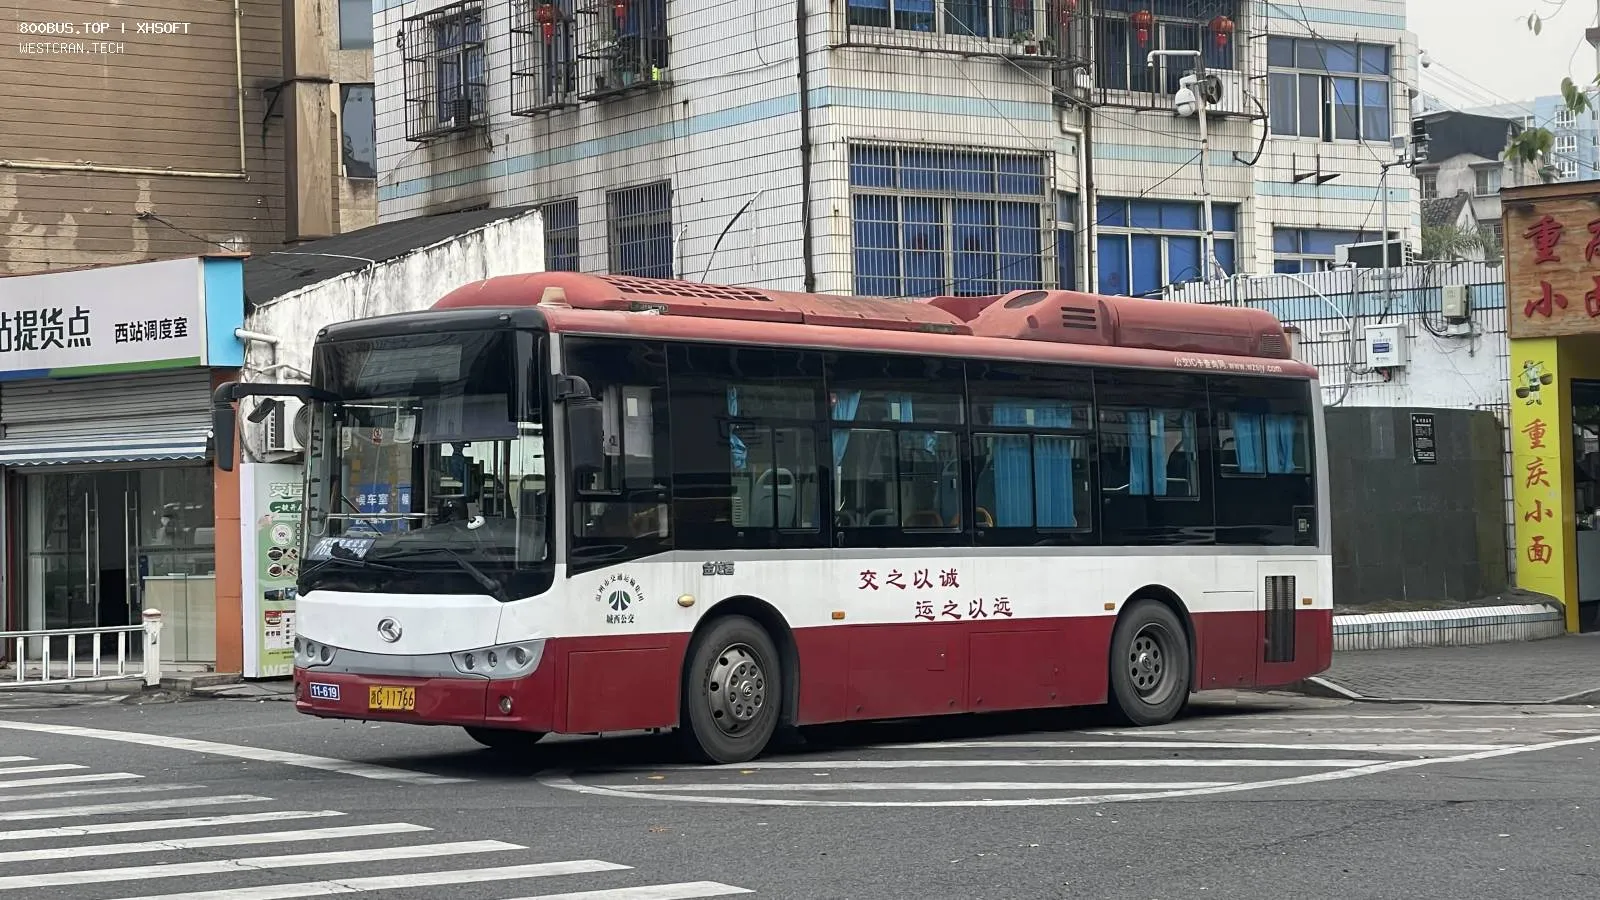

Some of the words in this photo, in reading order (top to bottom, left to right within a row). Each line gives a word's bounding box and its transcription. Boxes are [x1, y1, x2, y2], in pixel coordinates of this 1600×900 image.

[115, 317, 188, 344] 西站调度室
[1521, 418, 1554, 565] 重庆小面
[858, 568, 960, 591] 交之以诚
[606, 614, 635, 624] 城西公交
[914, 597, 1013, 621] 运之以远
[312, 685, 337, 698] 11-619
